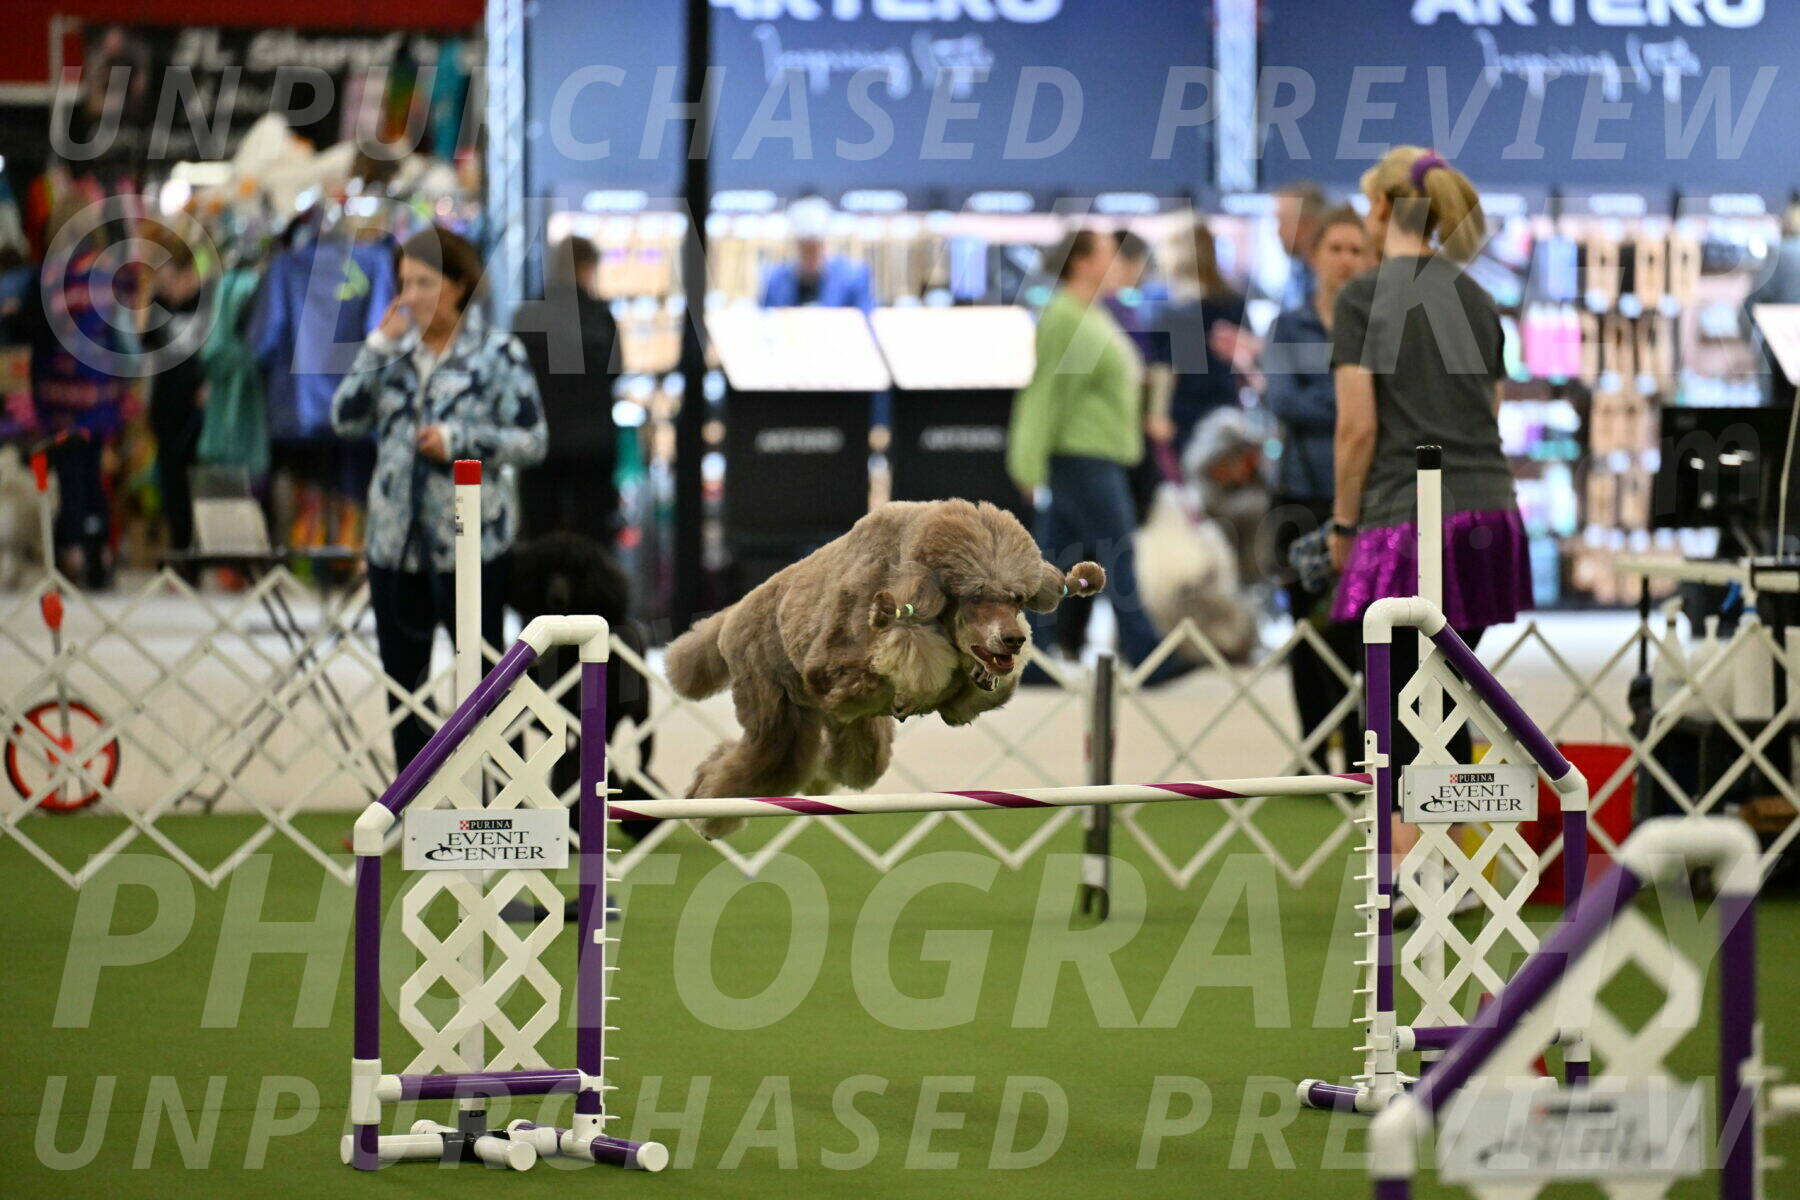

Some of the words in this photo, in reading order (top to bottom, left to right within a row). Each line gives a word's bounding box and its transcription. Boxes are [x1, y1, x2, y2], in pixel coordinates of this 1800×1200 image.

[1459, 773, 1494, 782] PURINA
[1440, 784, 1509, 798] EVENT
[1420, 798, 1522, 812] CENTER
[470, 820, 512, 829] PURINA
[448, 831, 529, 846] EVENT
[424, 846, 546, 861] CENTER
